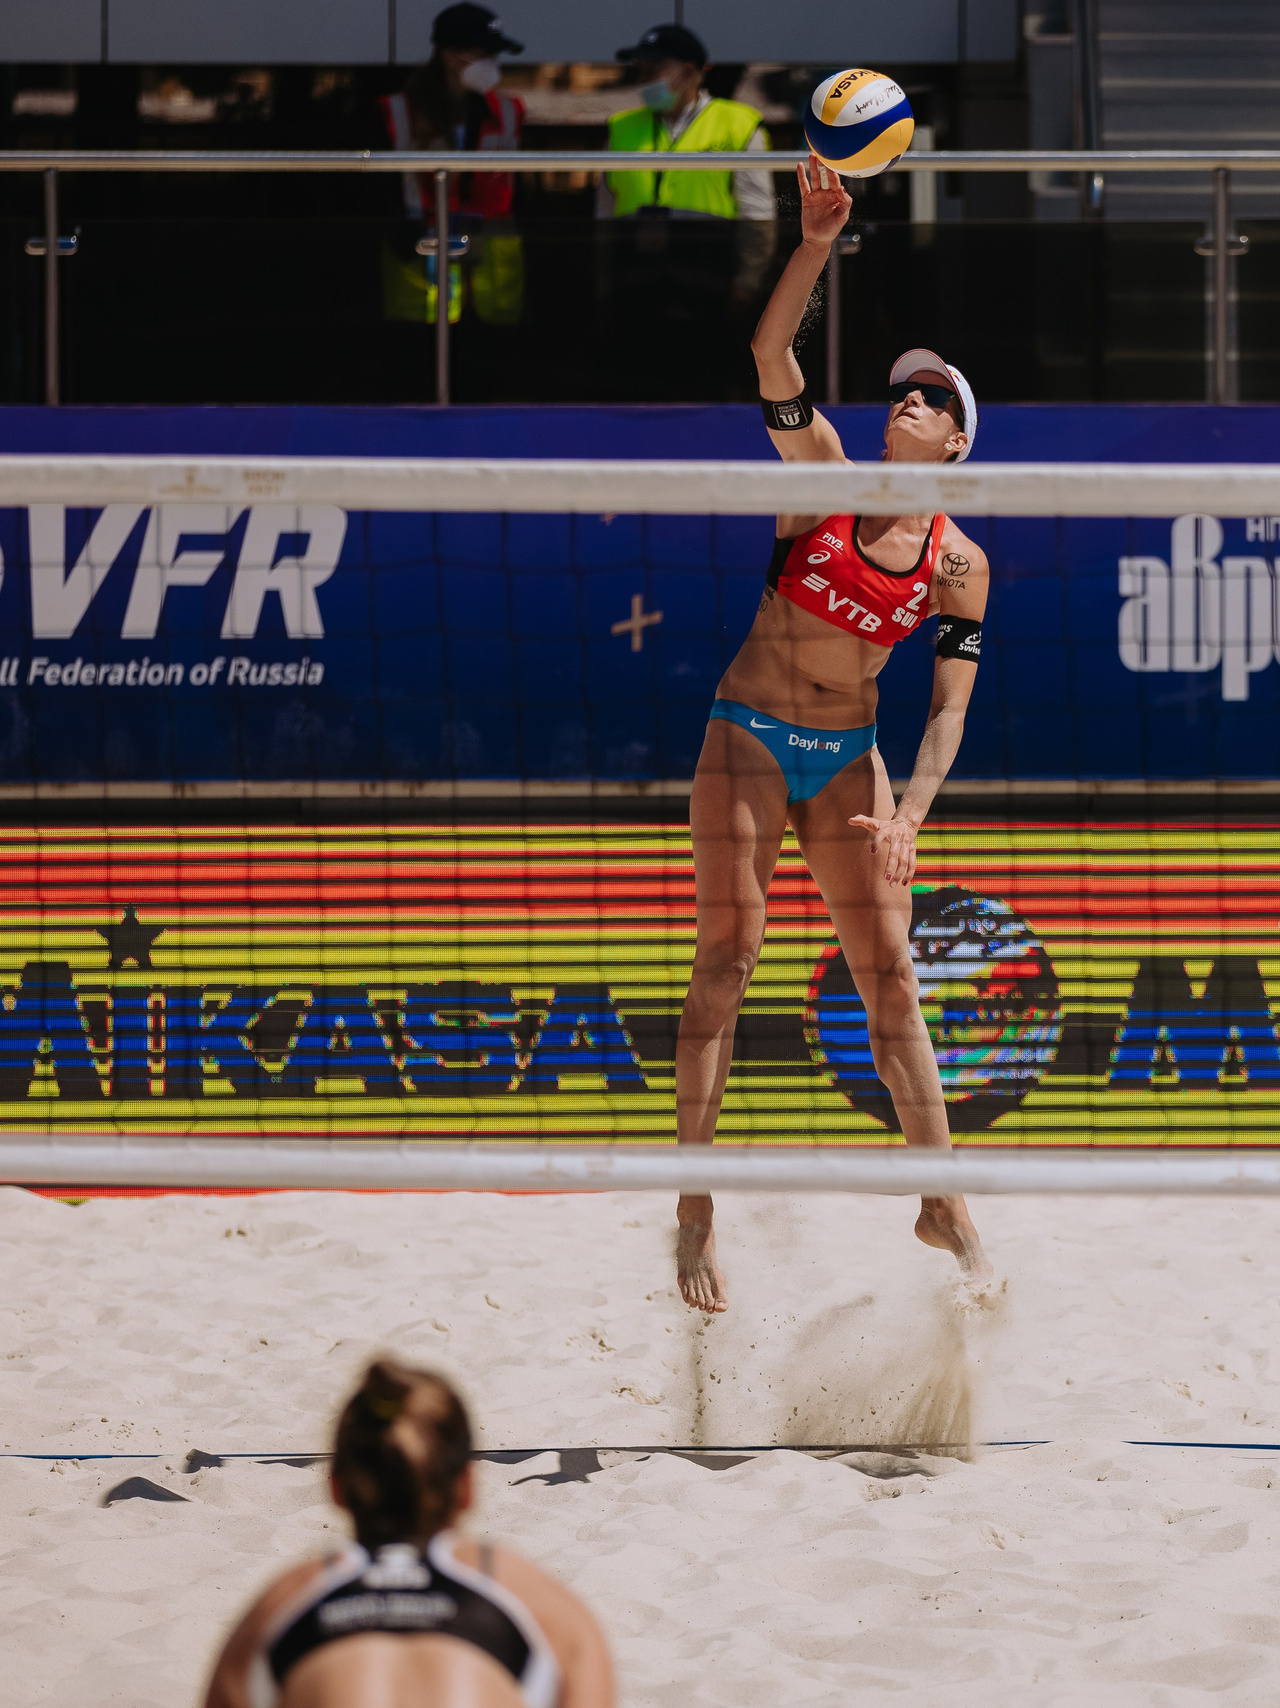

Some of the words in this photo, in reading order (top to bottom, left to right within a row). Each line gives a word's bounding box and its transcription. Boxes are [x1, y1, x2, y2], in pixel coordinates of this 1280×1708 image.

[28, 503, 348, 640] VFR
[936, 574, 966, 590] TOYOTA
[828, 589, 882, 633] VTB
[906, 582, 928, 611] 2
[892, 607, 919, 628] SUI
[27, 656, 184, 687] Federation
[189, 656, 226, 687] of
[227, 656, 325, 687] Russia
[788, 733, 842, 753] Daylong
